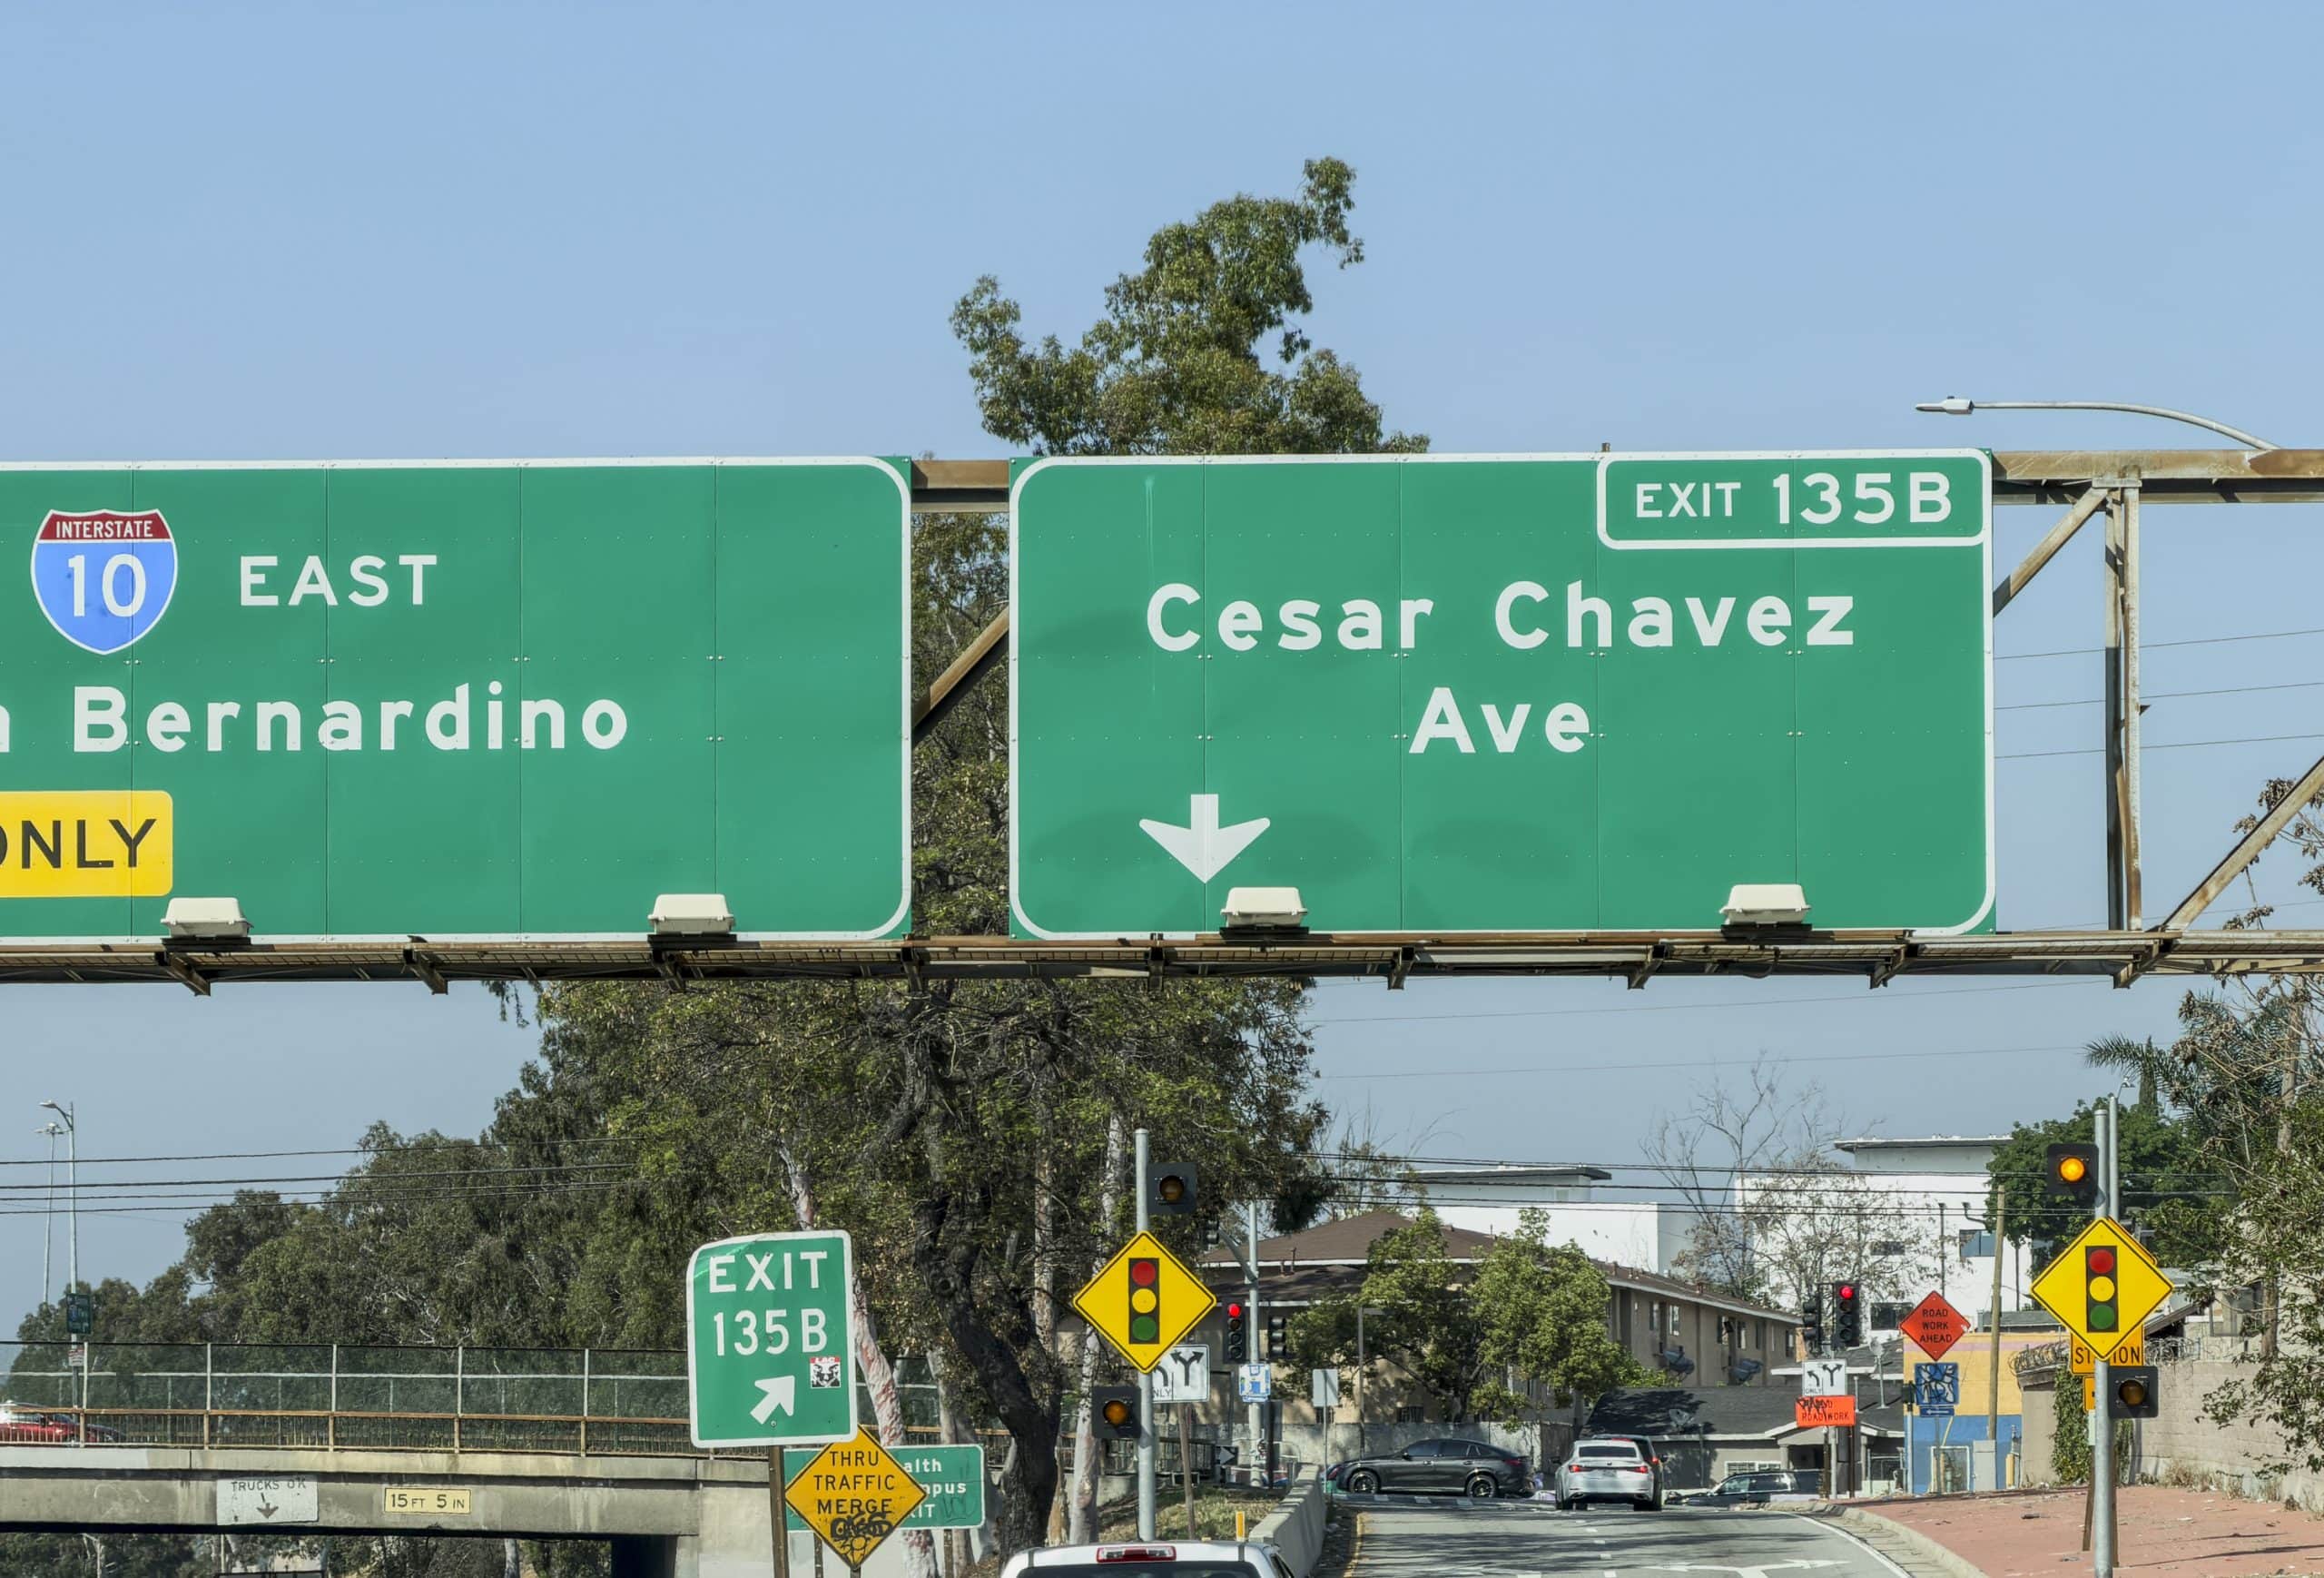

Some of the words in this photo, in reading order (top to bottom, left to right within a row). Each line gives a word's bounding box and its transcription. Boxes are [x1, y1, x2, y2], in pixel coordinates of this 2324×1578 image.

[1636, 482, 1741, 518] EXIT
[1772, 471, 1952, 525] 135B
[56, 520, 153, 538] INTERSTATE
[68, 553, 146, 617] 10
[240, 554, 438, 607] EAST
[1147, 583, 1434, 652] Cesar
[1494, 579, 1855, 650] Chavez
[74, 681, 627, 753] Bernardino
[1408, 687, 1590, 754] Ave
[0, 819, 156, 869] NLY
[708, 1250, 828, 1294] EXIT
[1922, 1308, 1948, 1317] ROAD
[714, 1307, 828, 1356] 135B
[1922, 1321, 1949, 1330] WORK
[1919, 1334, 1953, 1343] AHEAD
[2075, 1346, 2141, 1365] STION
[1153, 1388, 1171, 1397] NLY
[830, 1451, 880, 1467] THRU
[903, 1458, 942, 1473] alth
[231, 1481, 280, 1491] TRUCKS
[813, 1474, 895, 1491] TRAFFIC
[391, 1494, 408, 1507] 15
[411, 1498, 426, 1508] FT
[437, 1494, 447, 1508] 5
[453, 1499, 465, 1509] IN
[817, 1498, 893, 1514] MERGE
